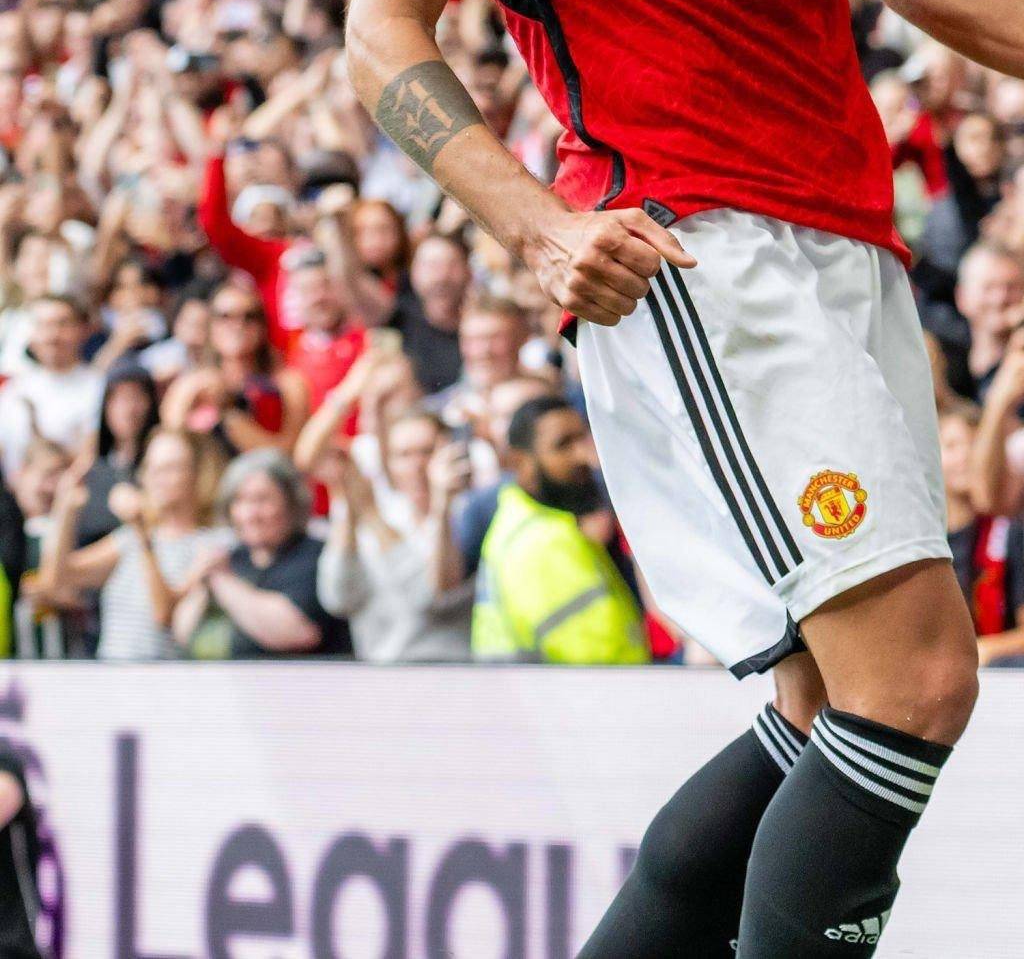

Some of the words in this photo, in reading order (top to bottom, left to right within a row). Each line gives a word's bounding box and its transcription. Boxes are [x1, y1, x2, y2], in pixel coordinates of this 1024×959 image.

[802, 474, 855, 508] MANCHESTER
[824, 514, 860, 536] UNITED
[113, 732, 640, 959] Leag
